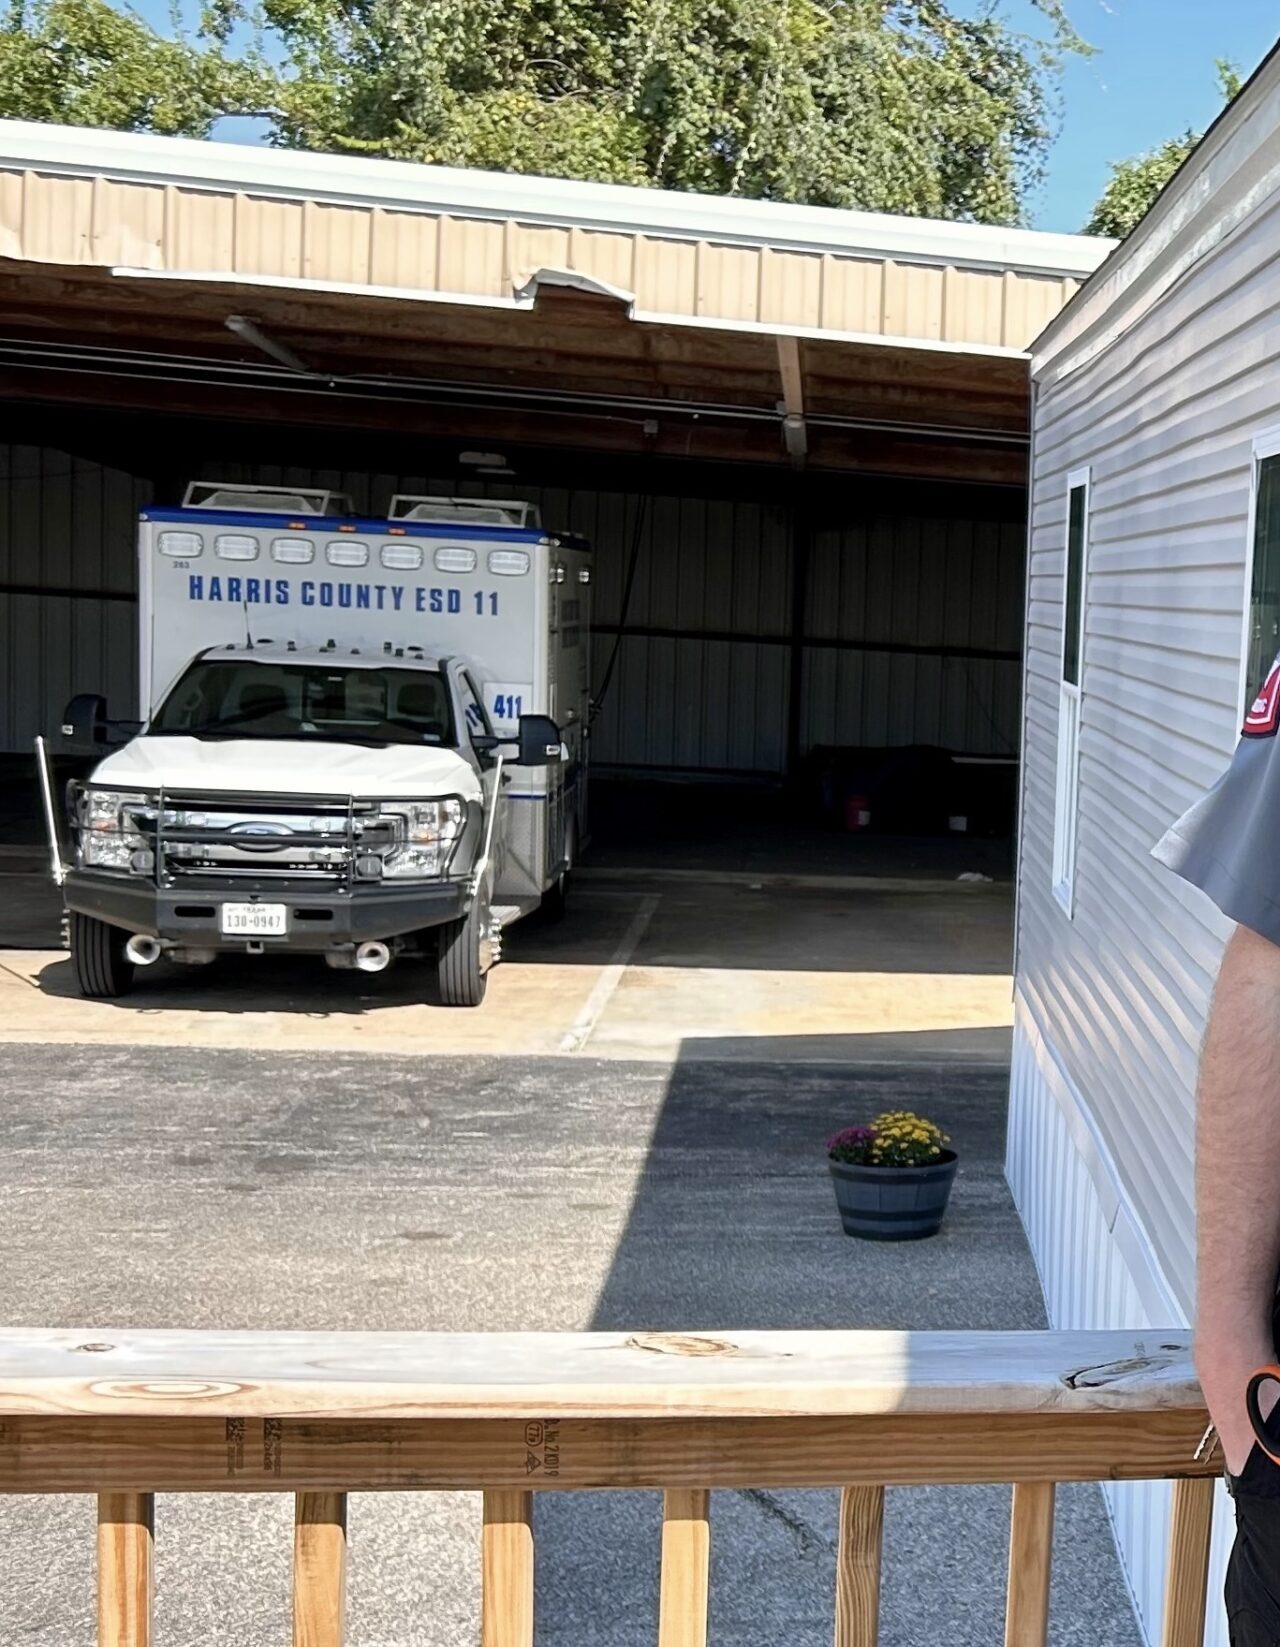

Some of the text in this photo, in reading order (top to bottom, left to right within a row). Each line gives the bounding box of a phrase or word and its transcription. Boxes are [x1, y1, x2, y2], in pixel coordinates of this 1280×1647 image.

[189, 575, 498, 616] HARRIS COUNTY ESD 11
[493, 694, 522, 719] 411
